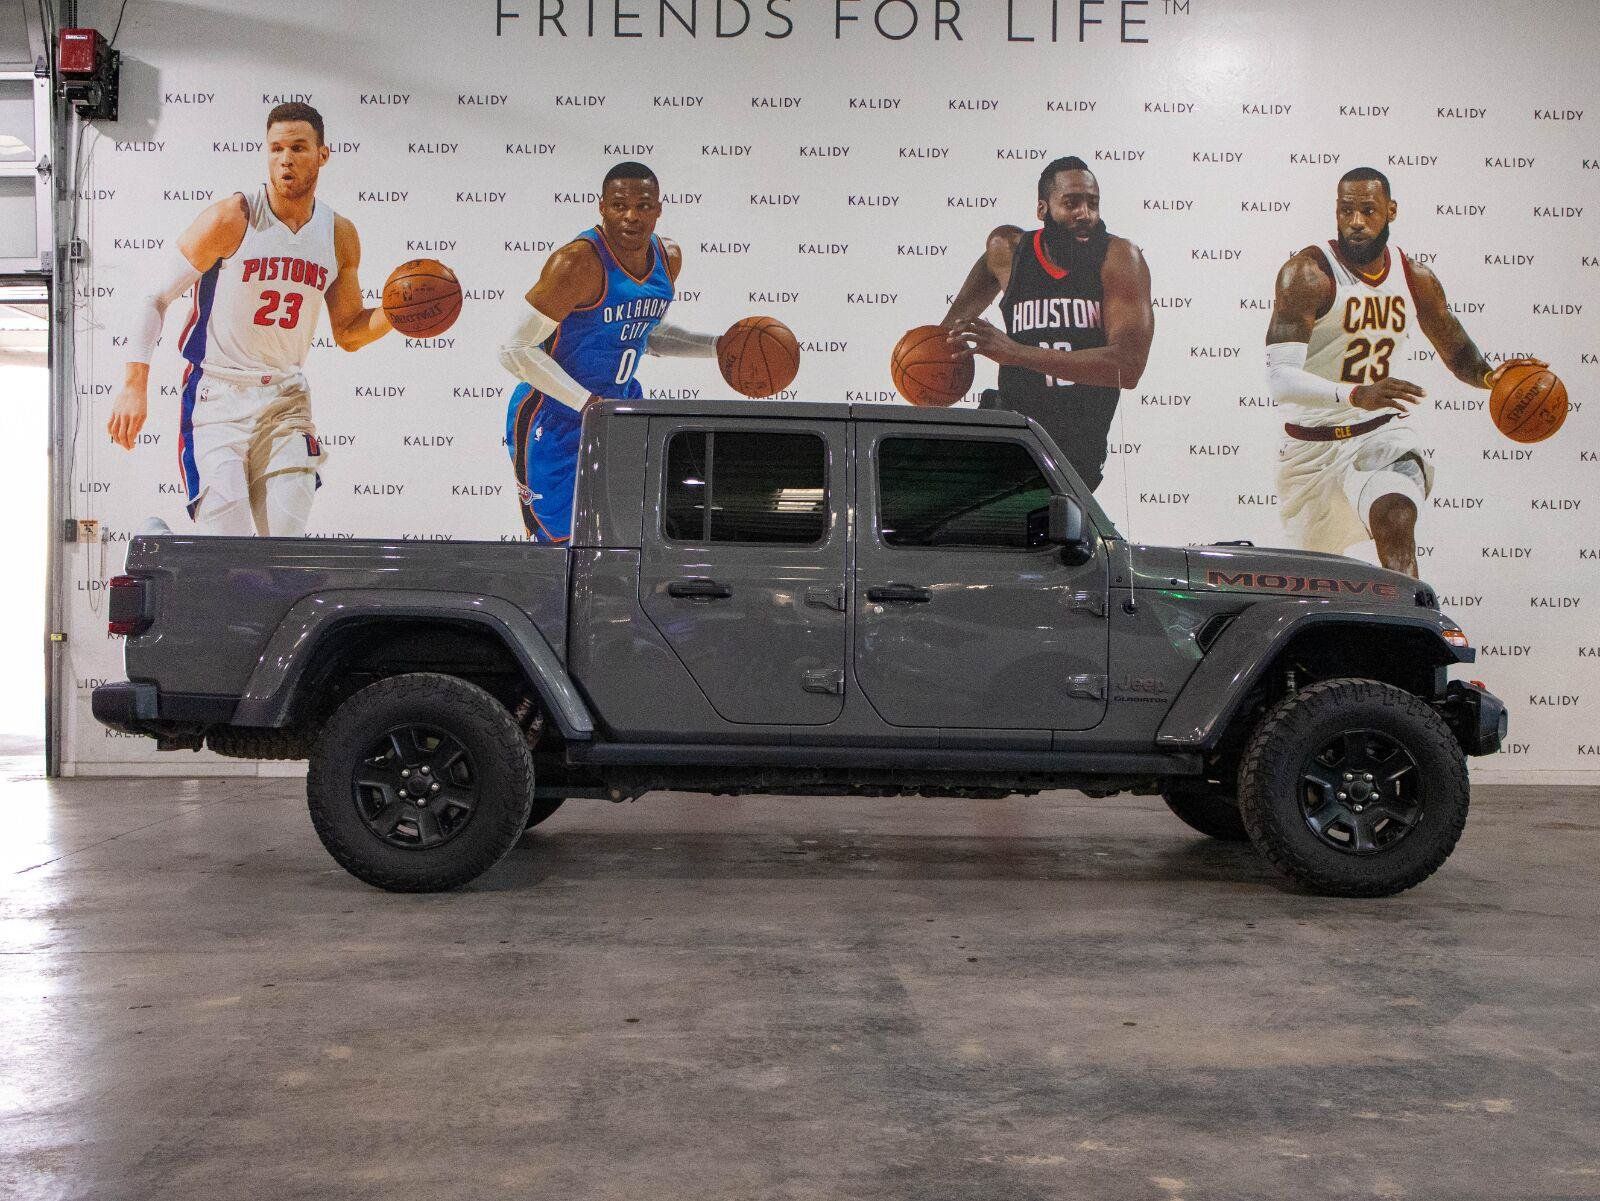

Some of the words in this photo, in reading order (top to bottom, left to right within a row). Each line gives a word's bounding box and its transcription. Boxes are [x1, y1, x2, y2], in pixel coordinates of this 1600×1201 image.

[496, 0, 793, 38] FRIENDS
[835, 0, 964, 40] FOR
[1007, 0, 1149, 43] LIFE
[166, 93, 214, 103] KALIDY
[263, 94, 312, 104] KALIDY
[361, 95, 410, 104] KALIDY
[458, 95, 507, 105] KALIDY
[556, 96, 605, 106] KALIDY
[654, 97, 703, 106] KALIDY
[752, 97, 801, 107] KALIDY
[850, 99, 900, 108] KALIDY
[949, 100, 998, 110] KALIDY
[1047, 101, 1096, 111] KALIDY
[1145, 103, 1194, 112] KALIDY
[1243, 104, 1291, 114] KALIDY
[1339, 106, 1389, 116] KALIDY
[1438, 108, 1486, 119] KALIDY
[1535, 110, 1583, 120] KALIDY
[116, 142, 164, 151] KALIDY
[214, 142, 262, 152] KALIDY
[330, 143, 360, 152] LIDY
[409, 143, 458, 153] KALIDY
[507, 144, 555, 154] KALIDY
[605, 145, 653, 154] KALIDY
[702, 146, 751, 155] KALIDY
[800, 147, 849, 156] KALIDY
[900, 148, 948, 158] KALIDY
[998, 149, 1046, 159] KALIDY
[1096, 151, 1144, 160] KALIDY
[1193, 152, 1242, 162] KALIDY
[1291, 154, 1340, 163] KALIDY
[1389, 156, 1437, 165] KALIDY
[1486, 157, 1534, 167] KALIDY
[164, 191, 213, 200] KALIDY
[359, 192, 408, 201] KALIDY
[457, 192, 506, 202] KALIDY
[662, 194, 702, 204] ALIDY
[751, 195, 800, 204] KALIDY
[849, 196, 899, 206] KALIDY
[948, 197, 997, 207] KALIDY
[1144, 200, 1193, 210] KALIDY
[1242, 202, 1290, 211] KALIDY
[1437, 205, 1485, 215] KALIDY
[1534, 207, 1583, 217] KALIDY
[115, 239, 163, 249] KALIDY
[407, 241, 456, 250] KALIDY
[505, 242, 554, 251] KALIDY
[701, 243, 750, 253] KALIDY
[799, 244, 848, 254] KALIDY
[898, 245, 947, 255] KALIDY
[1192, 250, 1241, 259] KALIDY
[1485, 255, 1534, 265] KALIDY
[242, 256, 328, 291] PISTONS
[464, 290, 505, 300] ALIDY
[750, 292, 798, 302] KALIDY
[848, 293, 897, 303] KALIDY
[1152, 298, 1192, 307] ALIDY
[1241, 299, 1275, 309] KALI
[253, 290, 303, 329] 23
[603, 298, 668, 323] OKLAHOM
[1446, 303, 1485, 313] ALIDY
[1533, 304, 1582, 314] KALIDY
[1012, 298, 1100, 334] HOUSTON
[1343, 295, 1406, 334] CAVS
[620, 322, 649, 341] CITY
[406, 339, 455, 348] KALIDY
[1191, 347, 1240, 357] KALIDY
[1340, 337, 1396, 385] 23
[615, 348, 637, 385] 0
[81, 385, 112, 395] LIDY
[356, 387, 405, 396] KALIDY
[454, 387, 503, 397] KALIDY
[650, 389, 699, 398] KALIDY
[847, 391, 896, 401] KALIDY
[1142, 395, 1191, 405] KALIDY
[1435, 400, 1484, 410] KALIDY
[1334, 426, 1352, 439] CLE
[316, 436, 356, 446] ALIDY
[404, 436, 453, 446] KALIDY
[1106, 444, 1142, 454] LIDY
[1190, 445, 1239, 455] KALIDY
[1483, 450, 1532, 460] KALIDY
[80, 483, 110, 493] LIDY
[159, 484, 184, 493] KAL
[354, 485, 403, 494] KALIDY
[453, 486, 502, 495] KALIDY
[1140, 493, 1189, 503] KALIDY
[1434, 499, 1483, 508] KALIDY
[1532, 500, 1580, 509] KALIDY
[1483, 548, 1531, 558] KALIDY
[78, 581, 109, 590] LIDY
[1207, 570, 1396, 597] MOJAVE
[1438, 596, 1482, 606] ALIDY
[1531, 598, 1580, 607] KALIDY
[1482, 646, 1530, 655] KALIDY
[76, 679, 107, 689] LIDY
[1530, 695, 1579, 705] KALIDY
[1498, 744, 1530, 754] LIDY
